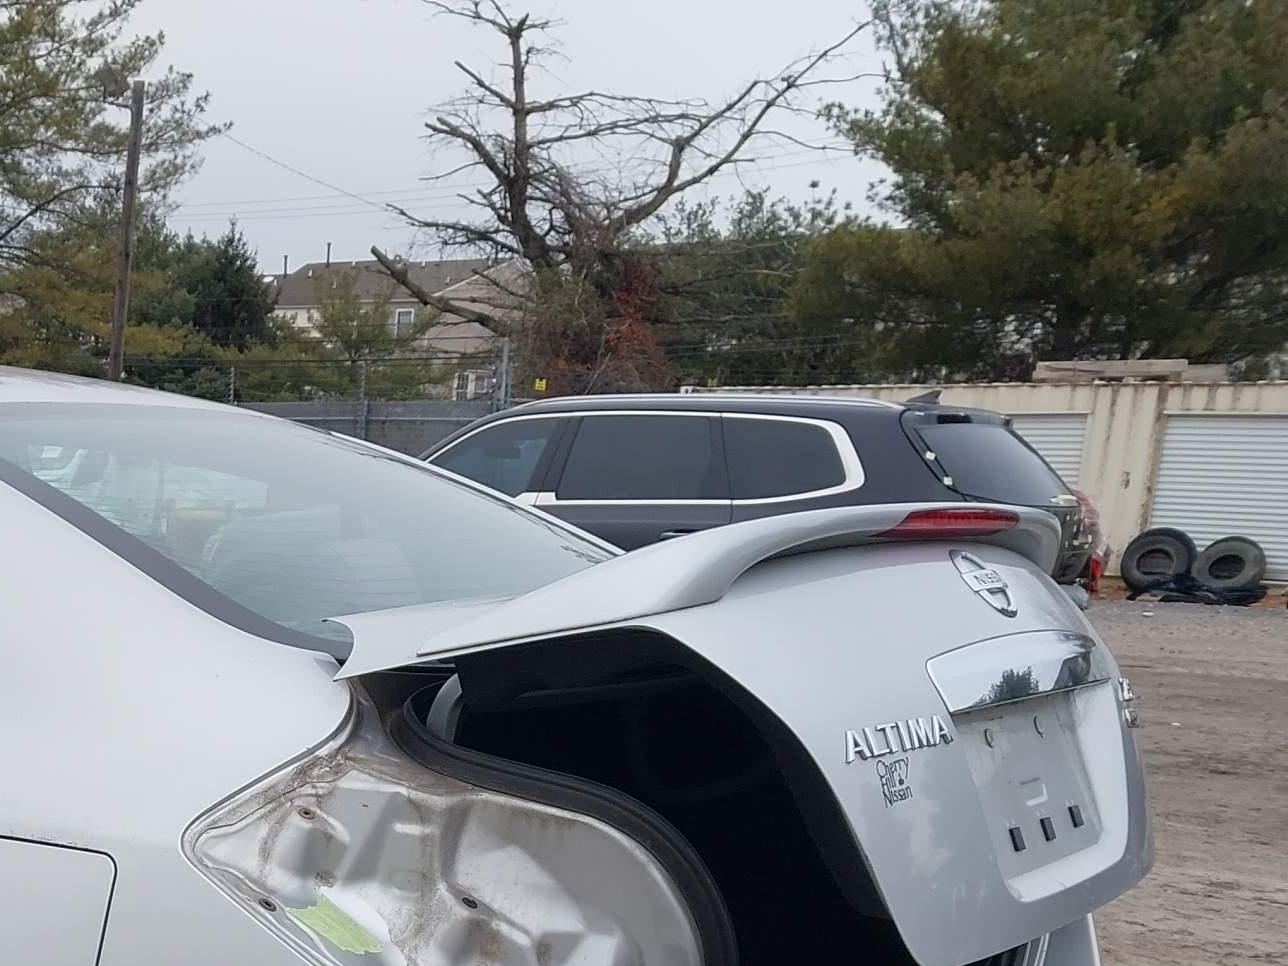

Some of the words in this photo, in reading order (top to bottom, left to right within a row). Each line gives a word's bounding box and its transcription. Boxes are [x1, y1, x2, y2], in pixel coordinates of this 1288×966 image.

[844, 715, 954, 764] ALTIMA
[876, 756, 909, 779] Cherry
[882, 785, 913, 808] Nissan
